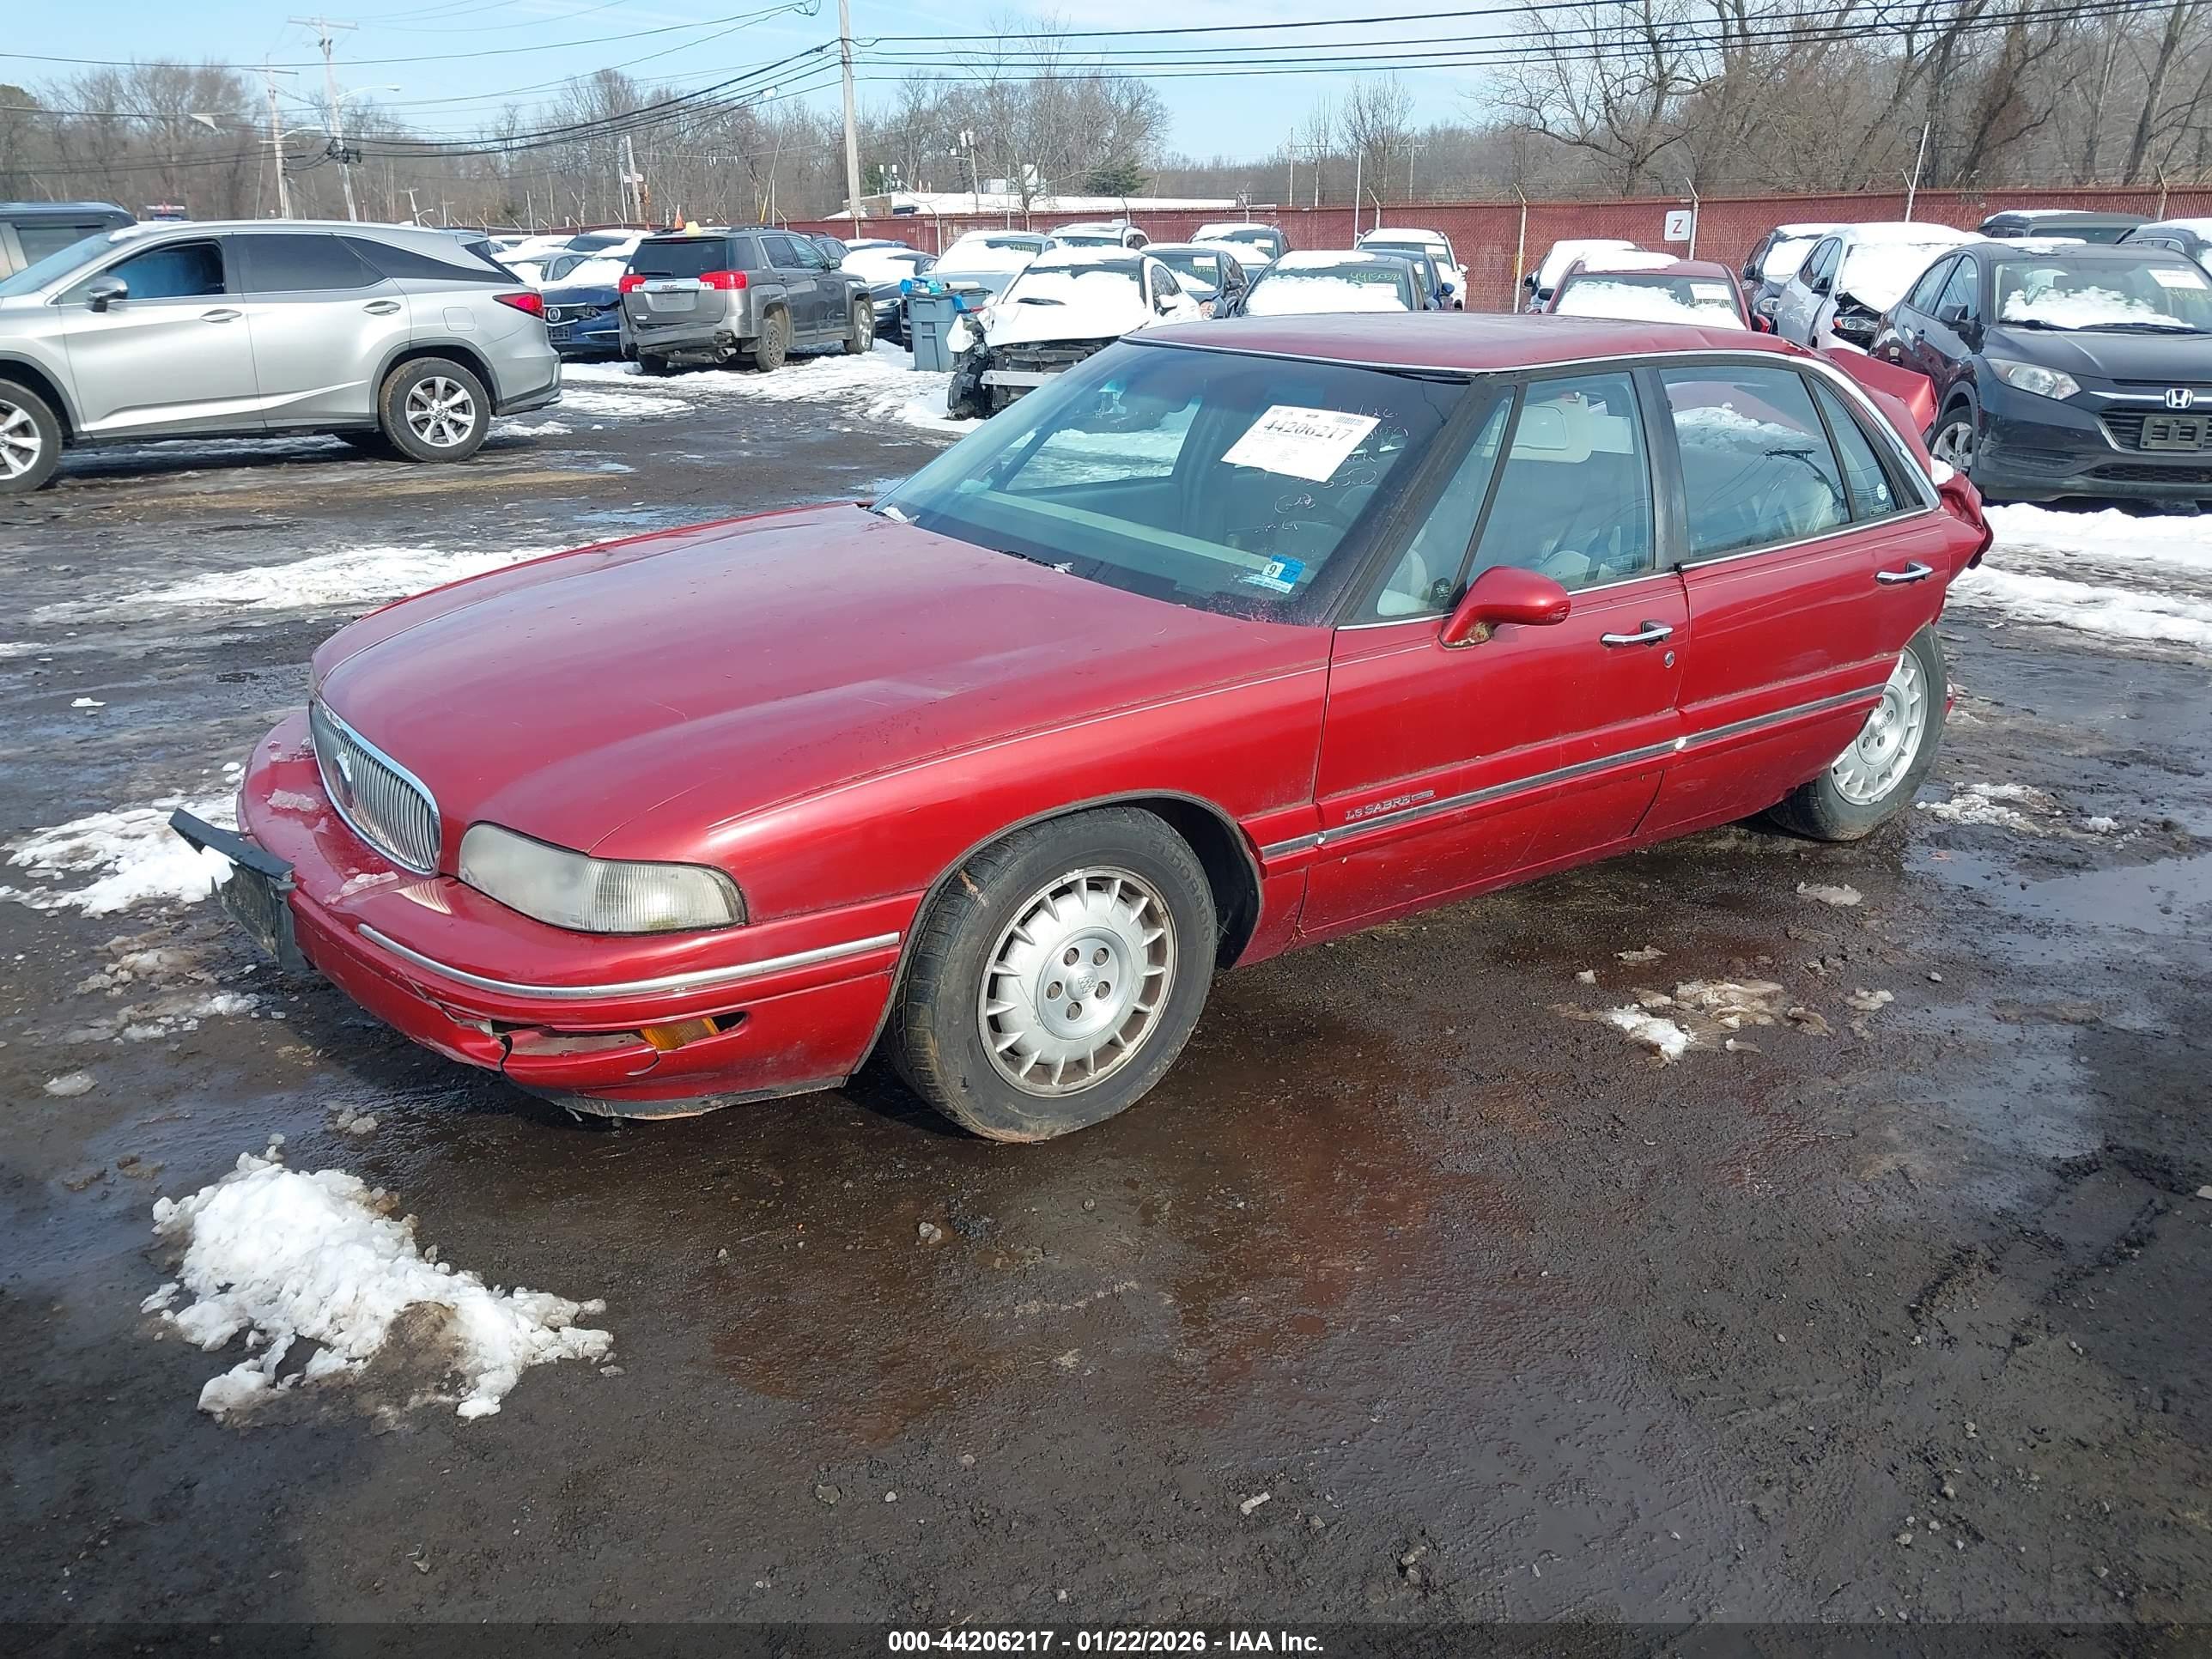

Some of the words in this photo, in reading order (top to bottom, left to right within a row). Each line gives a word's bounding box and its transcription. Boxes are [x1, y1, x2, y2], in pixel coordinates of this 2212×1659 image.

[1672, 218, 1684, 234] Z
[1263, 418, 1354, 441] 44206217
[1267, 563, 1278, 576] 9
[1283, 568, 1298, 579] 27
